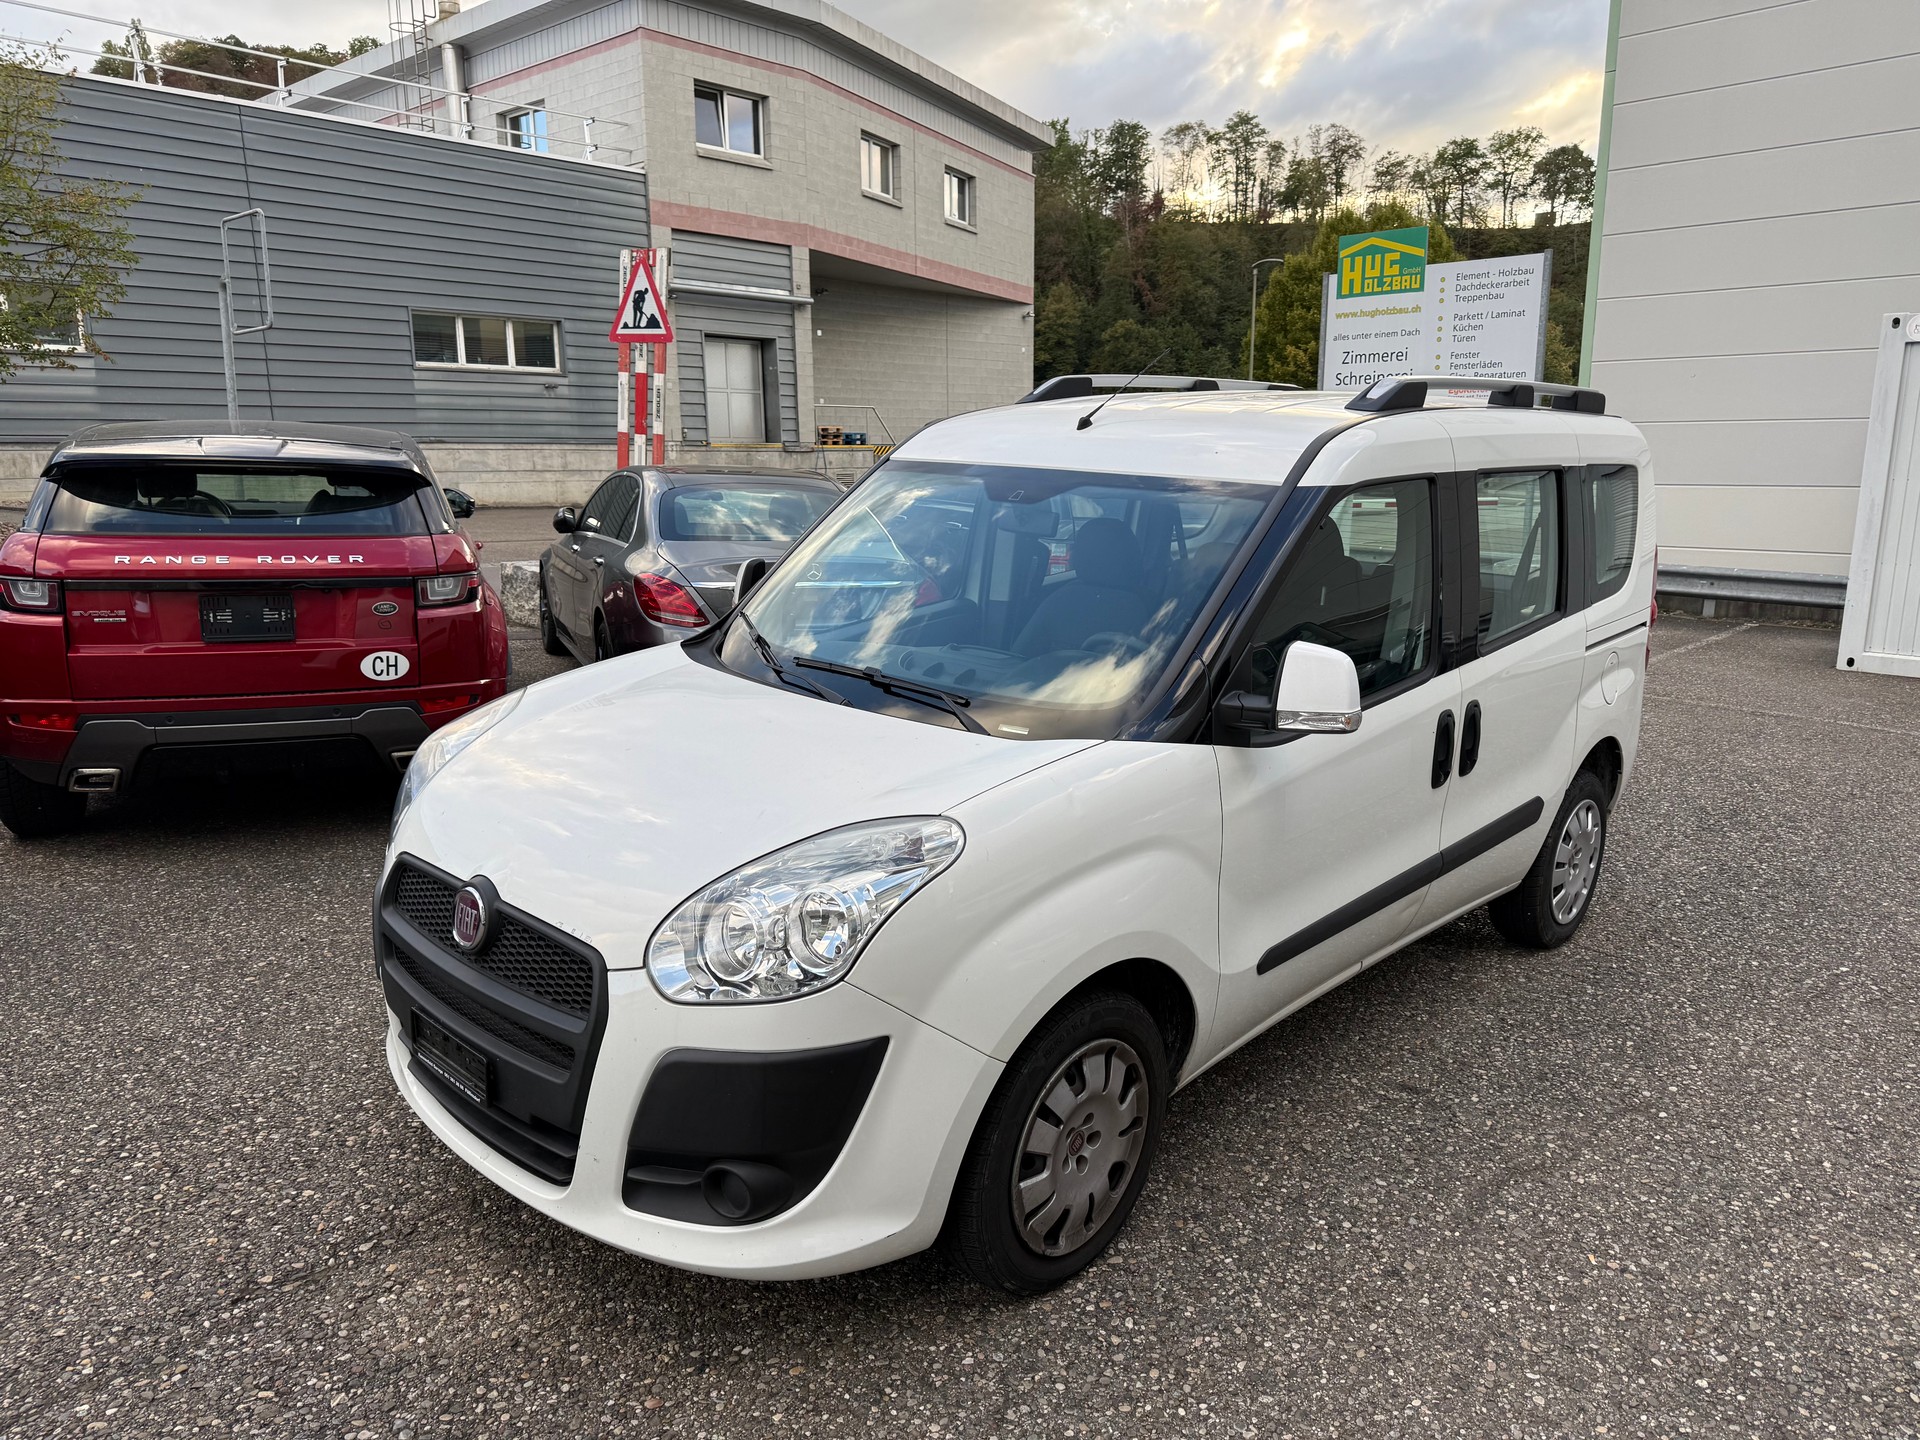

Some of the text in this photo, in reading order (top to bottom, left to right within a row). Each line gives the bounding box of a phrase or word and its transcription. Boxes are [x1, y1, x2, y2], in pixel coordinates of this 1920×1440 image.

[1402, 267, 1421, 275] GmbH
[1456, 271, 1490, 281] Element
[1498, 267, 1535, 277] Holzbau
[1455, 278, 1530, 292] Dachdeckerarbeit
[1454, 292, 1505, 303] Treppenbau
[1335, 304, 1422, 319] www.hugholzbau.ch
[1453, 312, 1484, 322] Parkett
[1491, 309, 1526, 319] Laminat
[1452, 323, 1484, 332] Küchen
[1333, 328, 1421, 341] alles unter einem Dach
[1452, 334, 1476, 343] Türen
[1341, 347, 1408, 365] Zimmerei
[1450, 351, 1481, 360] Fenster
[1449, 360, 1503, 370] Fensterläden
[1335, 368, 1413, 386] Schrei
[114, 554, 364, 565] RANGE ROVER
[71, 609, 126, 617] EVOQUE
[372, 656, 399, 677] CH
[457, 902, 478, 936] FIAT
